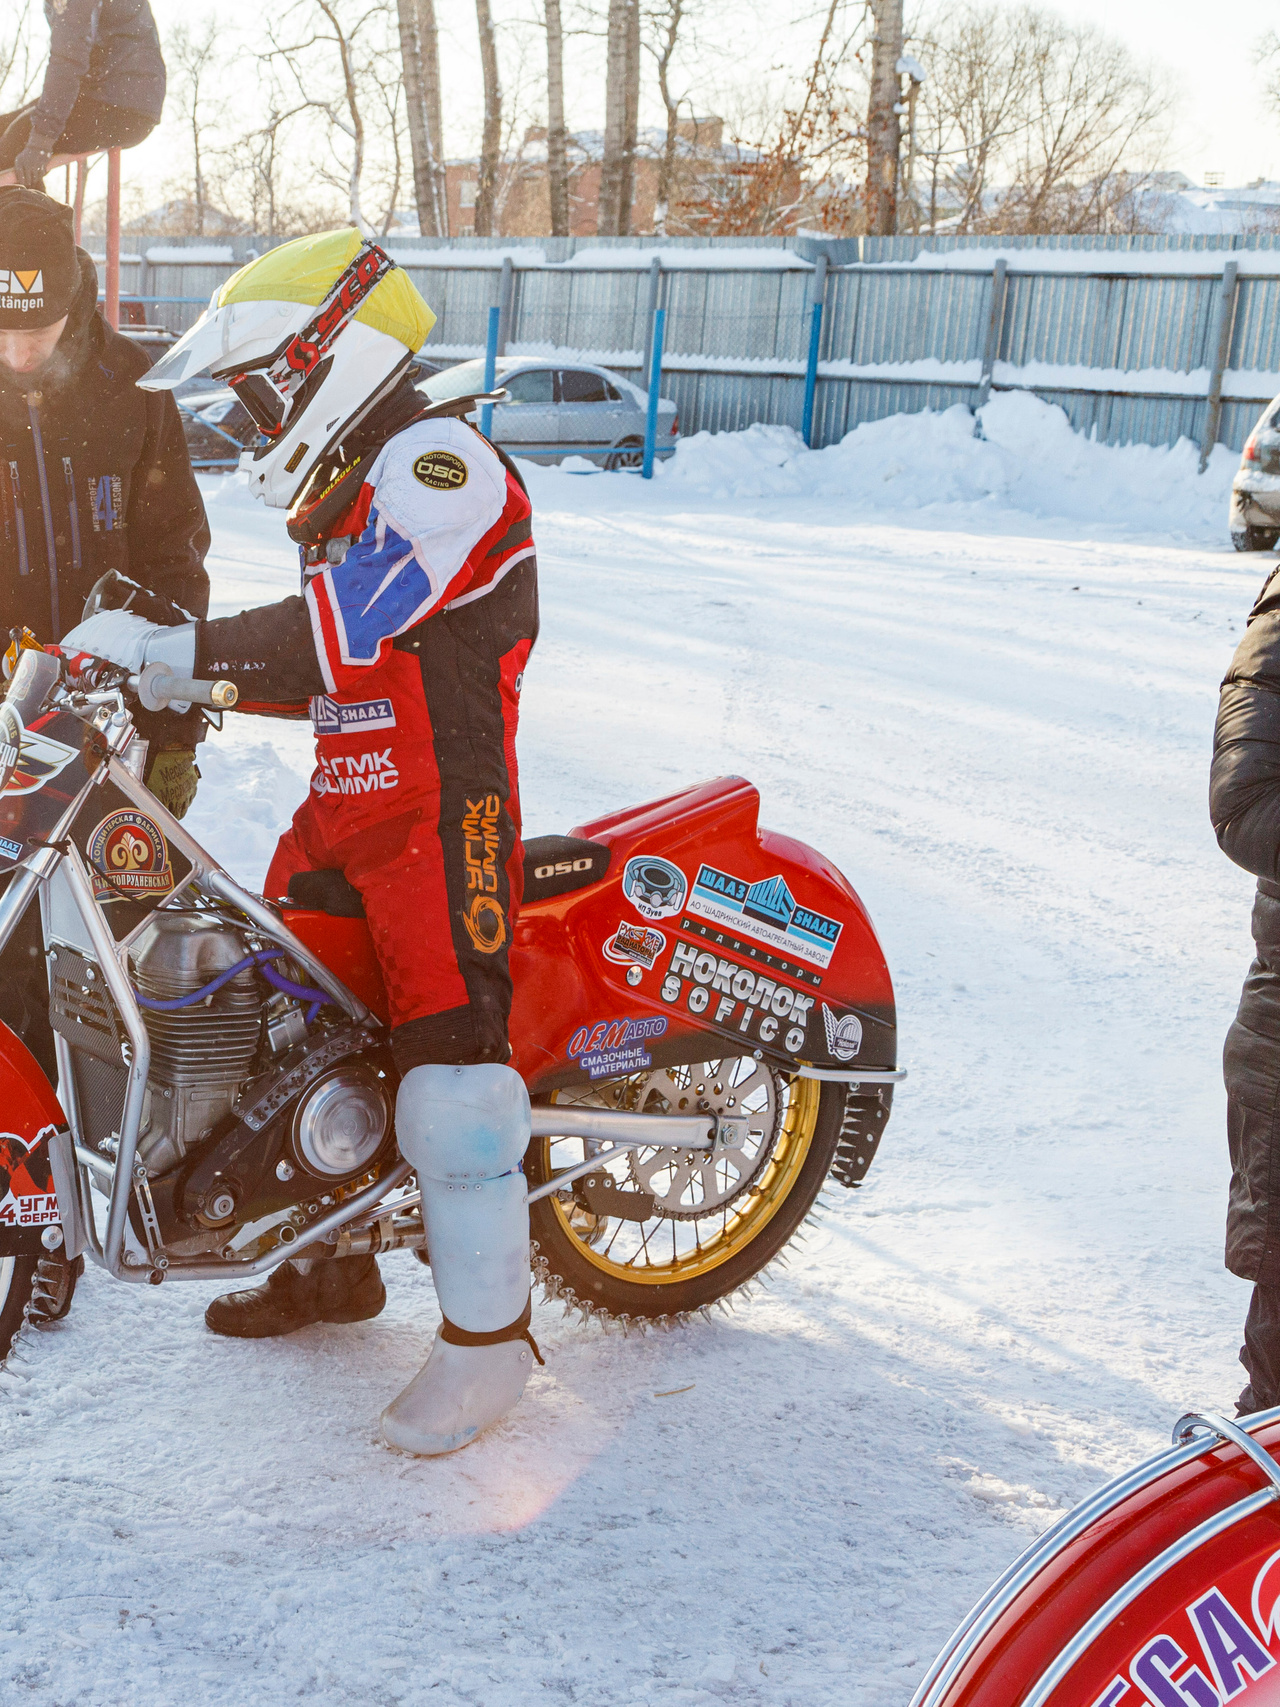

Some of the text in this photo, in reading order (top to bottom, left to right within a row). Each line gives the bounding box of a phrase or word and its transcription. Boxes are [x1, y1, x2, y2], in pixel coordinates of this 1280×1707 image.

[422, 453, 464, 470] MOTORSPORT
[320, 455, 361, 500] VOLKOV.M
[424, 476, 450, 488] RACING
[341, 704, 389, 722] SHAAZ
[320, 748, 396, 777] УГМК
[326, 769, 400, 795] UMMC
[93, 815, 162, 863] КОНДИТЕРСКАЯ ФАБРИКА
[462, 799, 485, 890] УГМК
[483, 794, 500, 893] UMMC
[534, 857, 593, 879] OSO
[699, 869, 746, 899] ШААЗ
[690, 900, 702, 910] АО
[793, 910, 838, 939] SHAAZ
[682, 919, 821, 985] радиаторы
[670, 942, 815, 1027] НОКОЛОК
[661, 975, 806, 1054] SOFICO
[581, 1047, 642, 1067] СМАЗОЧНЫЕ
[591, 1056, 650, 1076] МАТЕРИАЛЫ
[20, 1196, 59, 1213] УГМ
[20, 1211, 62, 1224] ФЕРР
